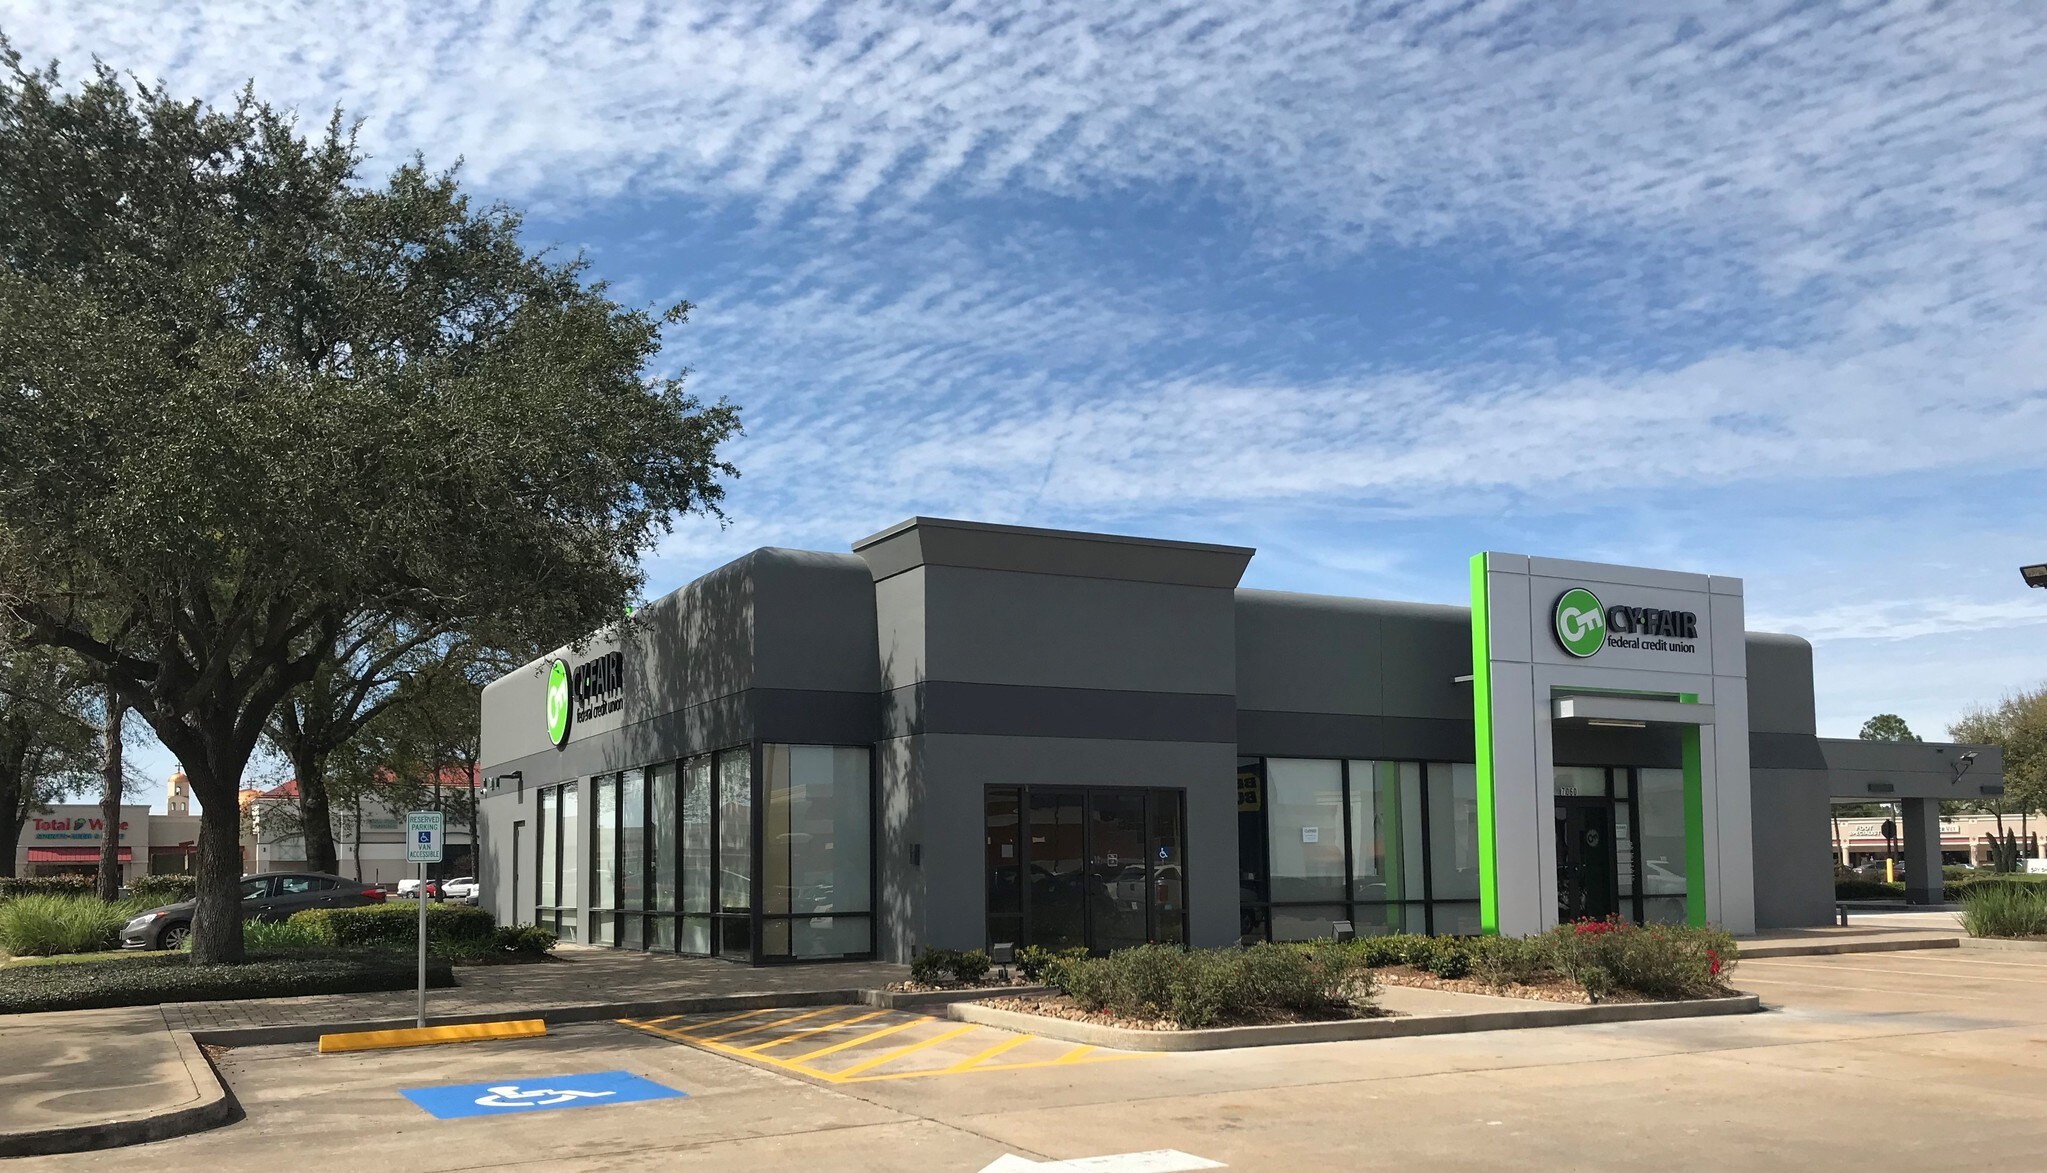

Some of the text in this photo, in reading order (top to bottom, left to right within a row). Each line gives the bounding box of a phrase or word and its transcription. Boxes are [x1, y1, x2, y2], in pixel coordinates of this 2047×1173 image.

[1607, 635, 1695, 654] federal credit union
[577, 698, 624, 724] federal credit union
[33, 818, 129, 831] Total We
